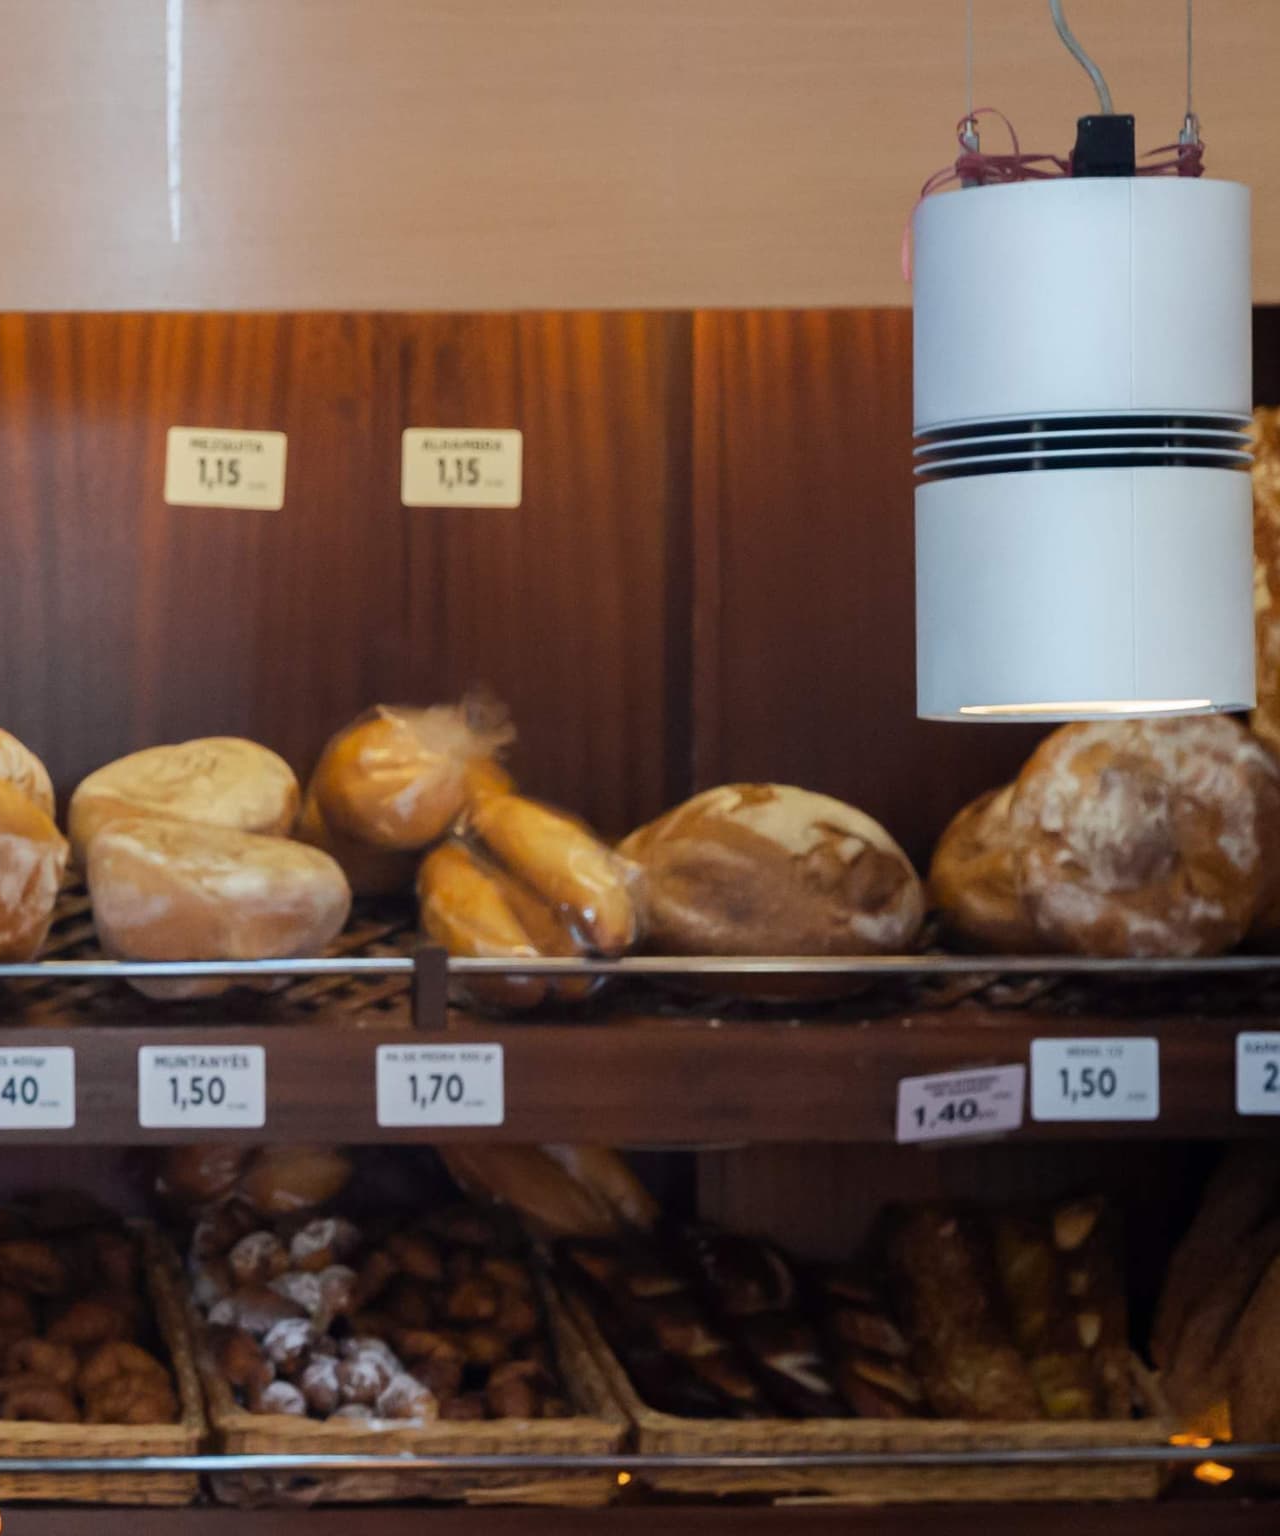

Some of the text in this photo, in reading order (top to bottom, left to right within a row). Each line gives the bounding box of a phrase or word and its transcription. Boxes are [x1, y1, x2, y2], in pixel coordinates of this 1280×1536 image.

[198, 457, 240, 490] 1,15
[438, 457, 480, 491] 1,15
[170, 1076, 225, 1112] 1,50
[409, 1073, 464, 1110] 1,70
[1060, 1067, 1116, 1104] 1,50
[913, 1098, 978, 1130] 1,40
